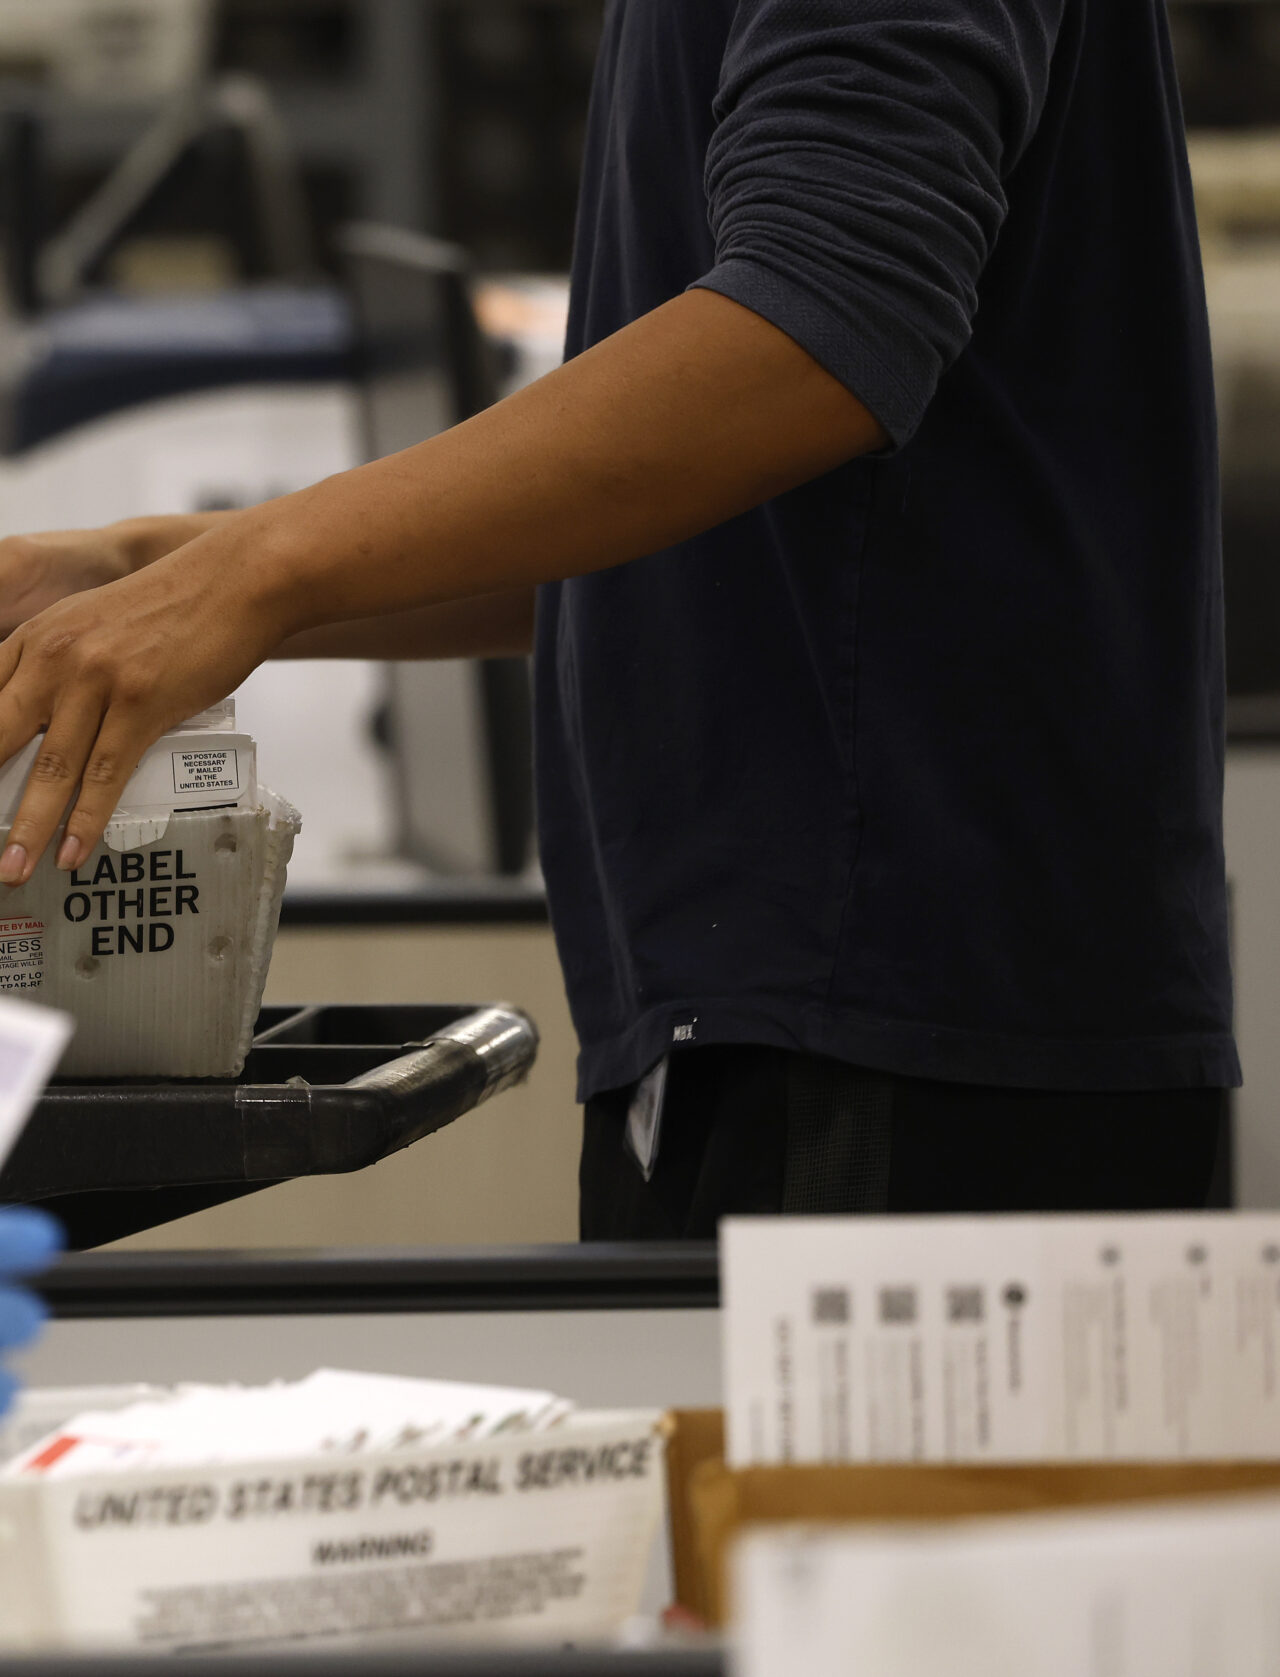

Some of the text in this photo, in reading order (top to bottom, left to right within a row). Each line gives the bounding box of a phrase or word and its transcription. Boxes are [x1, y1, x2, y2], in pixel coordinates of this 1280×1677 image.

[70, 850, 196, 886] LABEL
[64, 885, 200, 922] OTHER
[11, 922, 24, 931] BY
[25, 921, 45, 929] MAIL
[91, 922, 175, 956] END
[13, 973, 26, 981] OF
[20, 960, 36, 968] WILL
[73, 1438, 653, 1528] UNITED STATES POSTAL SERVICE
